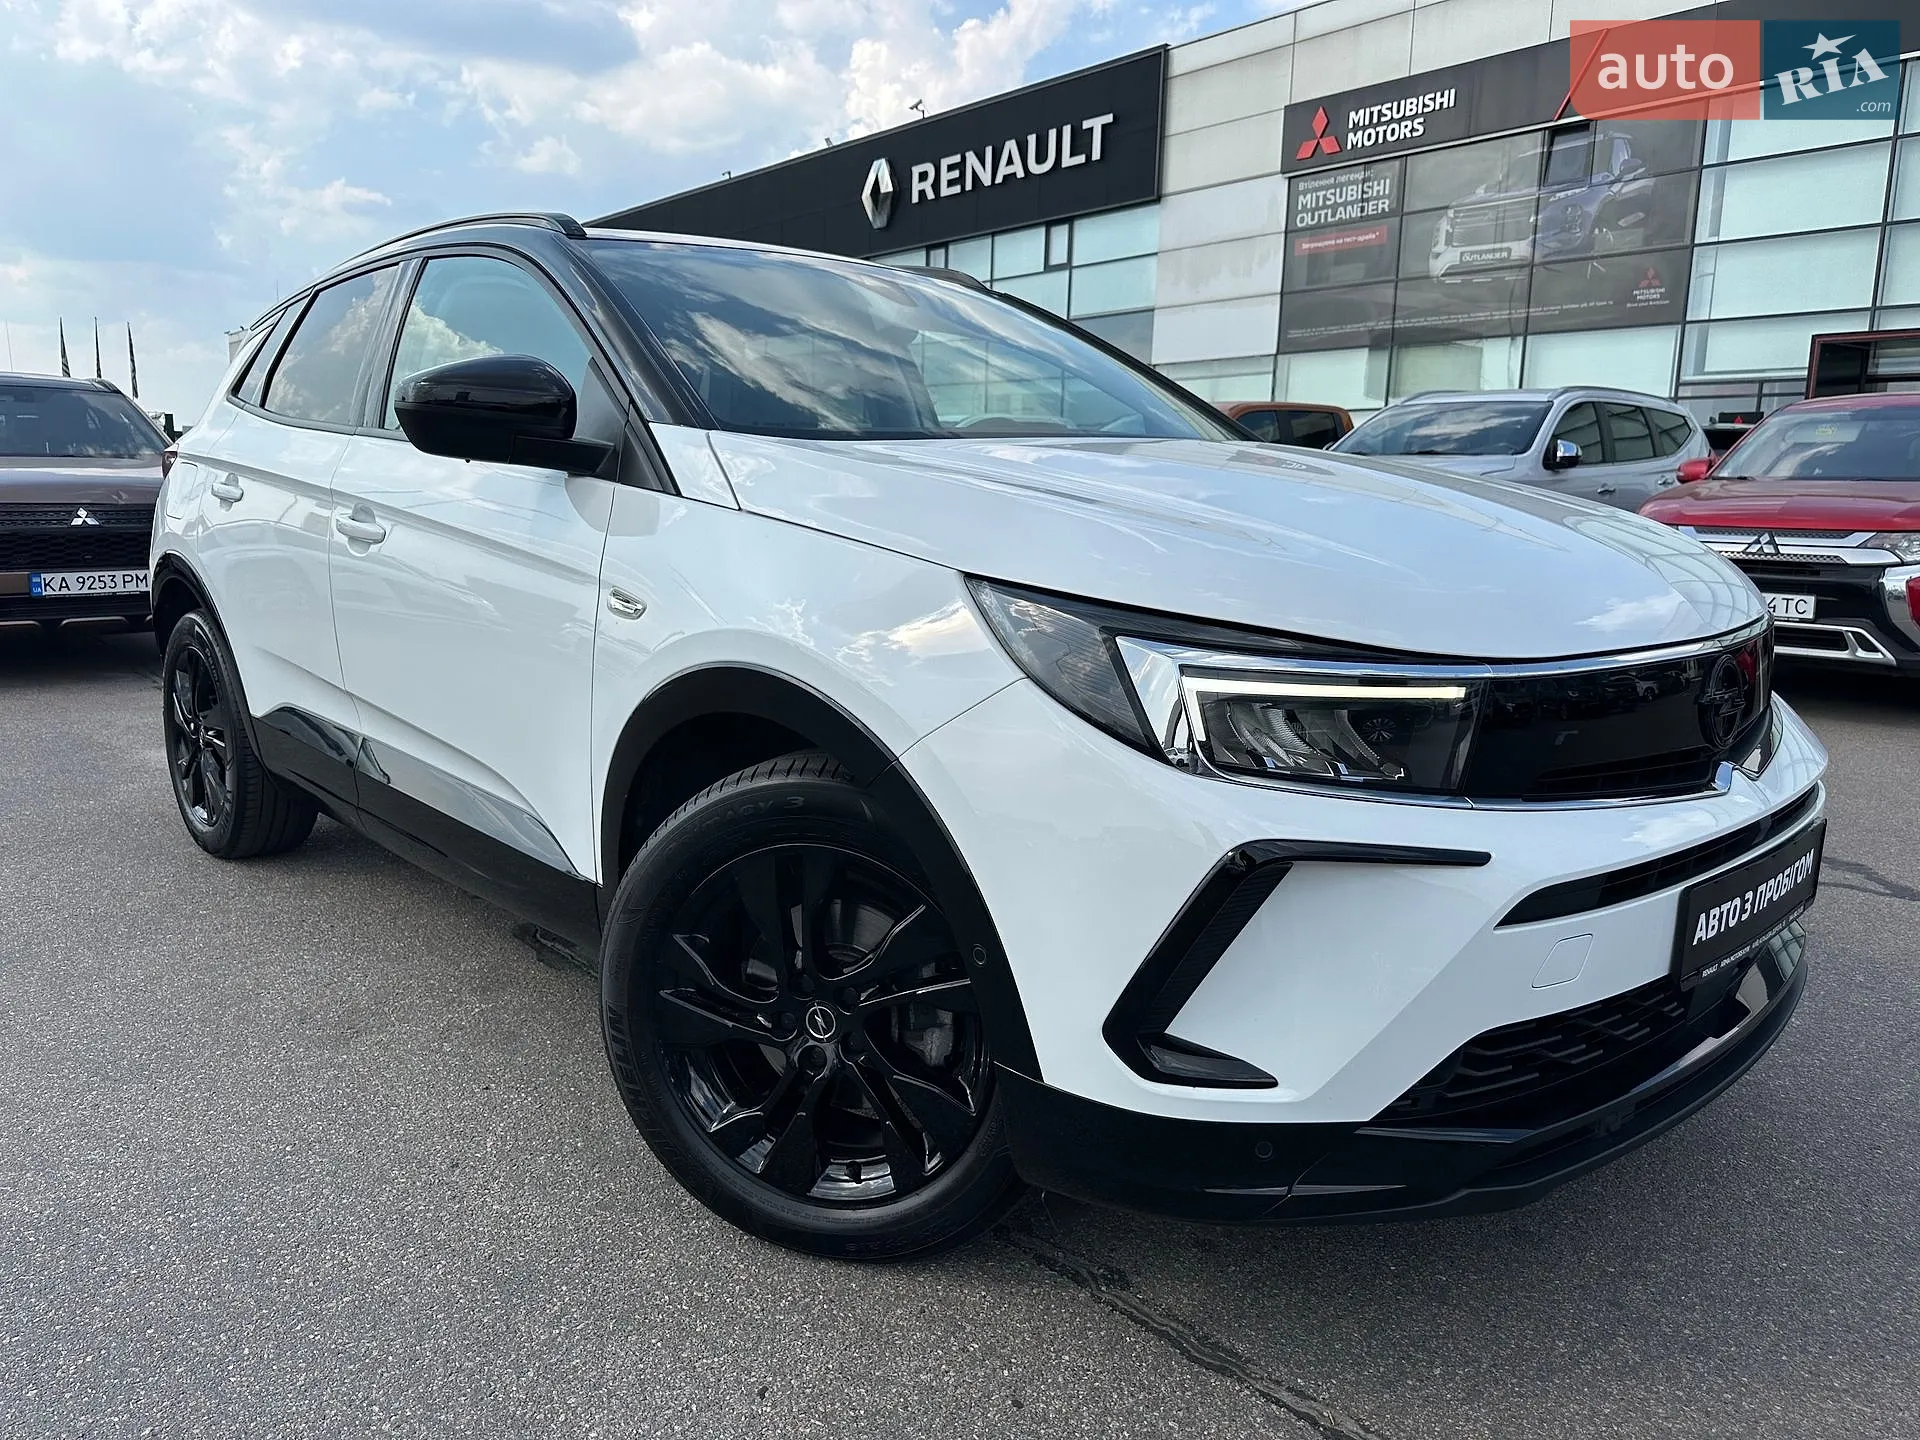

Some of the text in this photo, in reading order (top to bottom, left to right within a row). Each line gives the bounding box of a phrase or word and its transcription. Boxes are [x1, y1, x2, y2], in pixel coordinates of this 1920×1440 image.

[1348, 88, 1456, 129] MITSUBISHI
[1346, 117, 1425, 150] MOTORS
[911, 113, 1114, 204] RENAULT
[1297, 178, 1390, 210] MITSUBISHI
[1296, 199, 1390, 228] OUTLANDER
[43, 573, 149, 592] KA 9253 PM
[1781, 597, 1808, 614] TC
[1692, 896, 1741, 945] АВТО
[1741, 890, 1754, 922] З
[1753, 848, 1815, 914] ПРОБІГОМ
